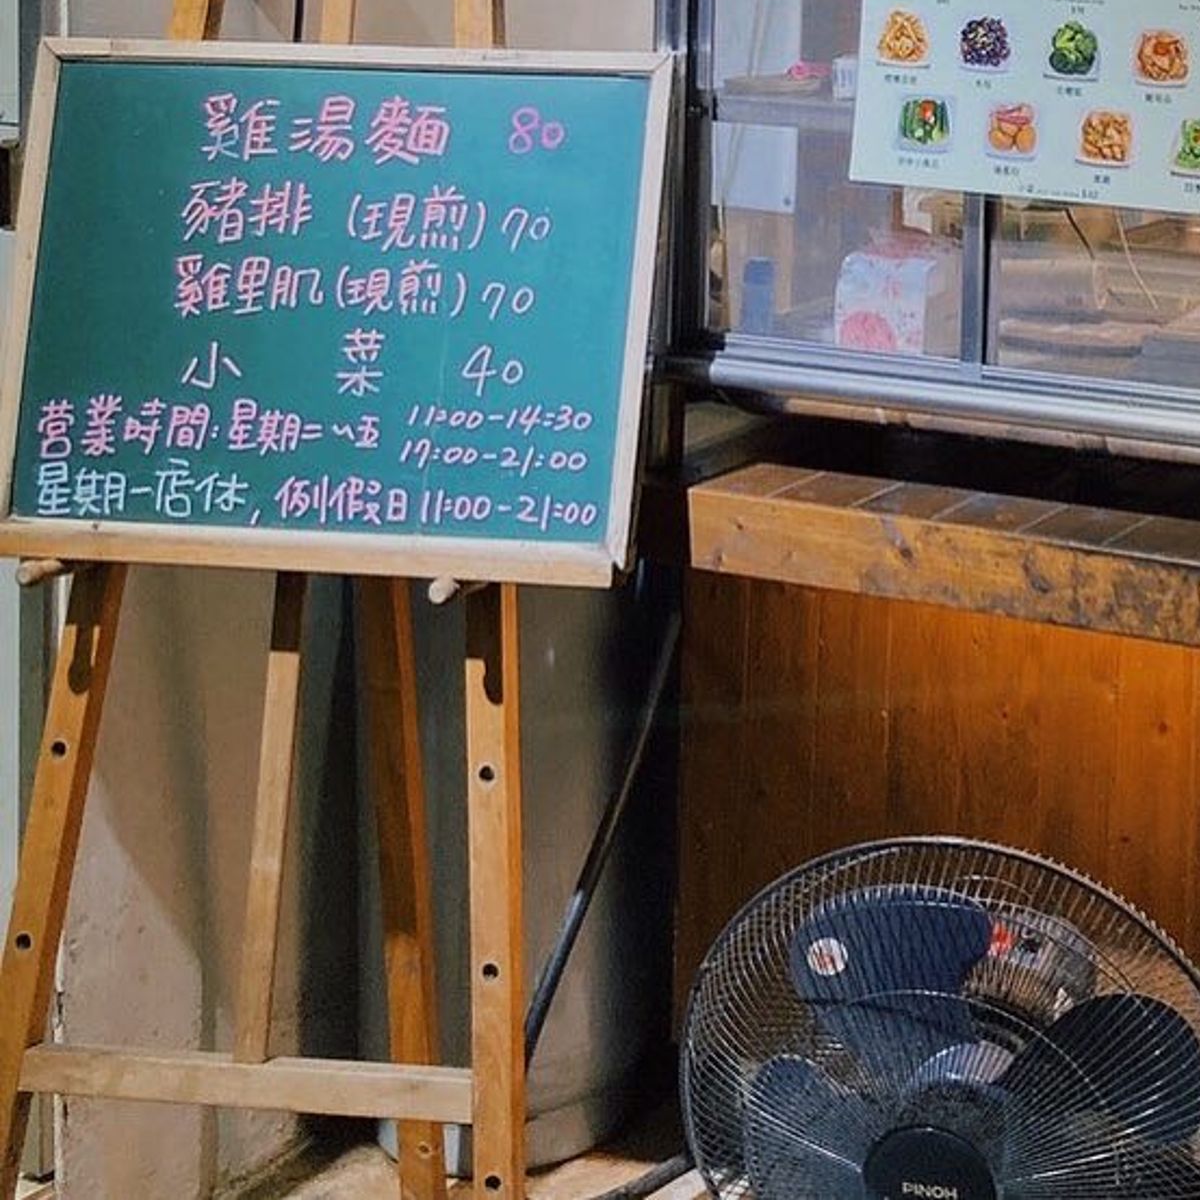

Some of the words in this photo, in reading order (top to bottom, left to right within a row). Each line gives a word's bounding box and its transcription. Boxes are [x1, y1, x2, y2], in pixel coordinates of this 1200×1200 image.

[201, 94, 451, 165] 雞湯麵
[507, 106, 565, 155] 80
[181, 175, 312, 243] 豬排
[501, 206, 551, 252] 70
[481, 283, 535, 321] 70
[461, 344, 525, 398] 40
[408, 403, 593, 436] 11:00-14:30
[400, 438, 588, 478] 17:00-21:00
